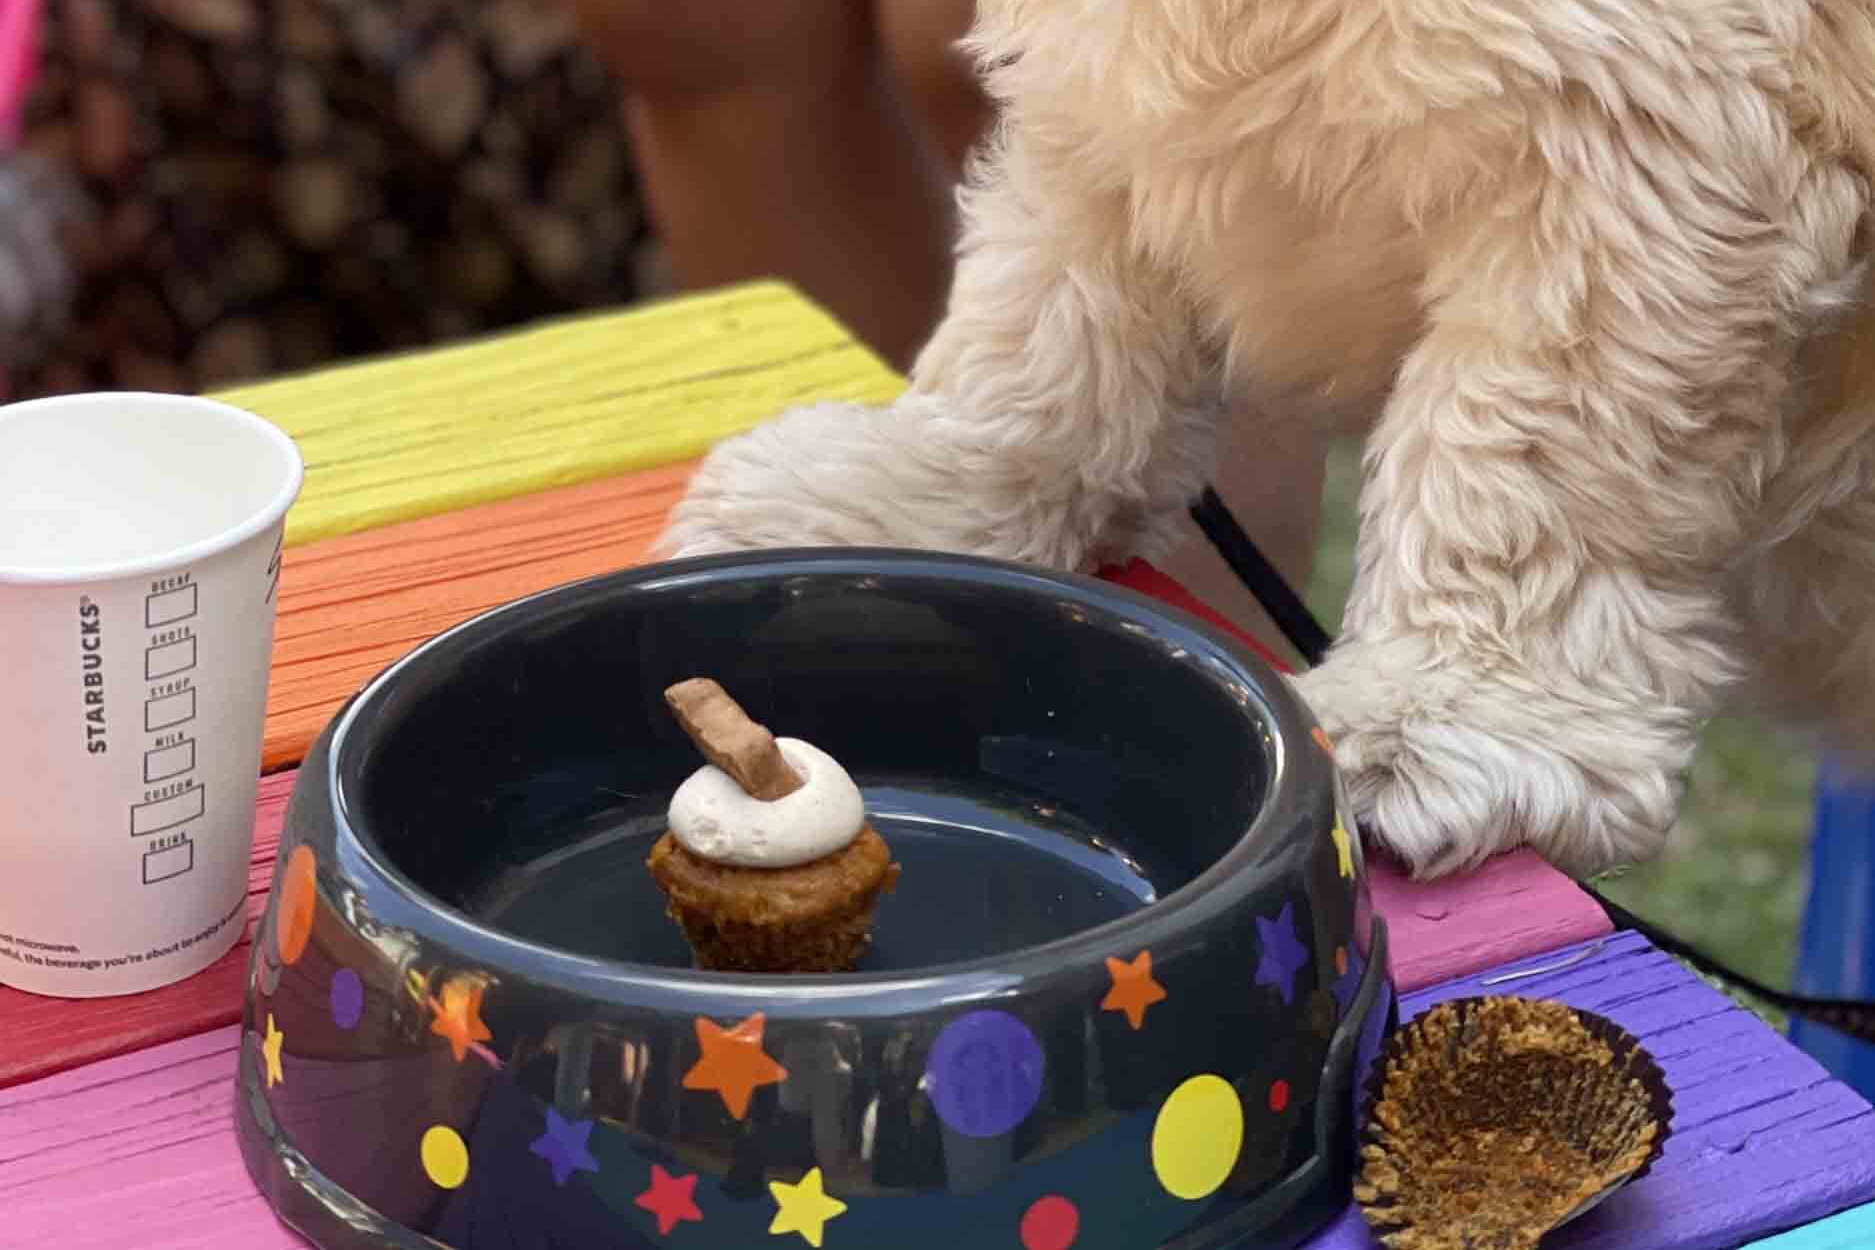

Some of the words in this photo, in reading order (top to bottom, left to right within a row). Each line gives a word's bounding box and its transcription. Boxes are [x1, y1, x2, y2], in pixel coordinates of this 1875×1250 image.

[151, 572, 190, 592] DECAF
[151, 625, 190, 646] SHOTS
[150, 677, 191, 696] SYRUP
[155, 731, 184, 748] MILK
[144, 778, 193, 802] CUSTOM
[149, 831, 187, 850] DRINK
[145, 942, 179, 961] about
